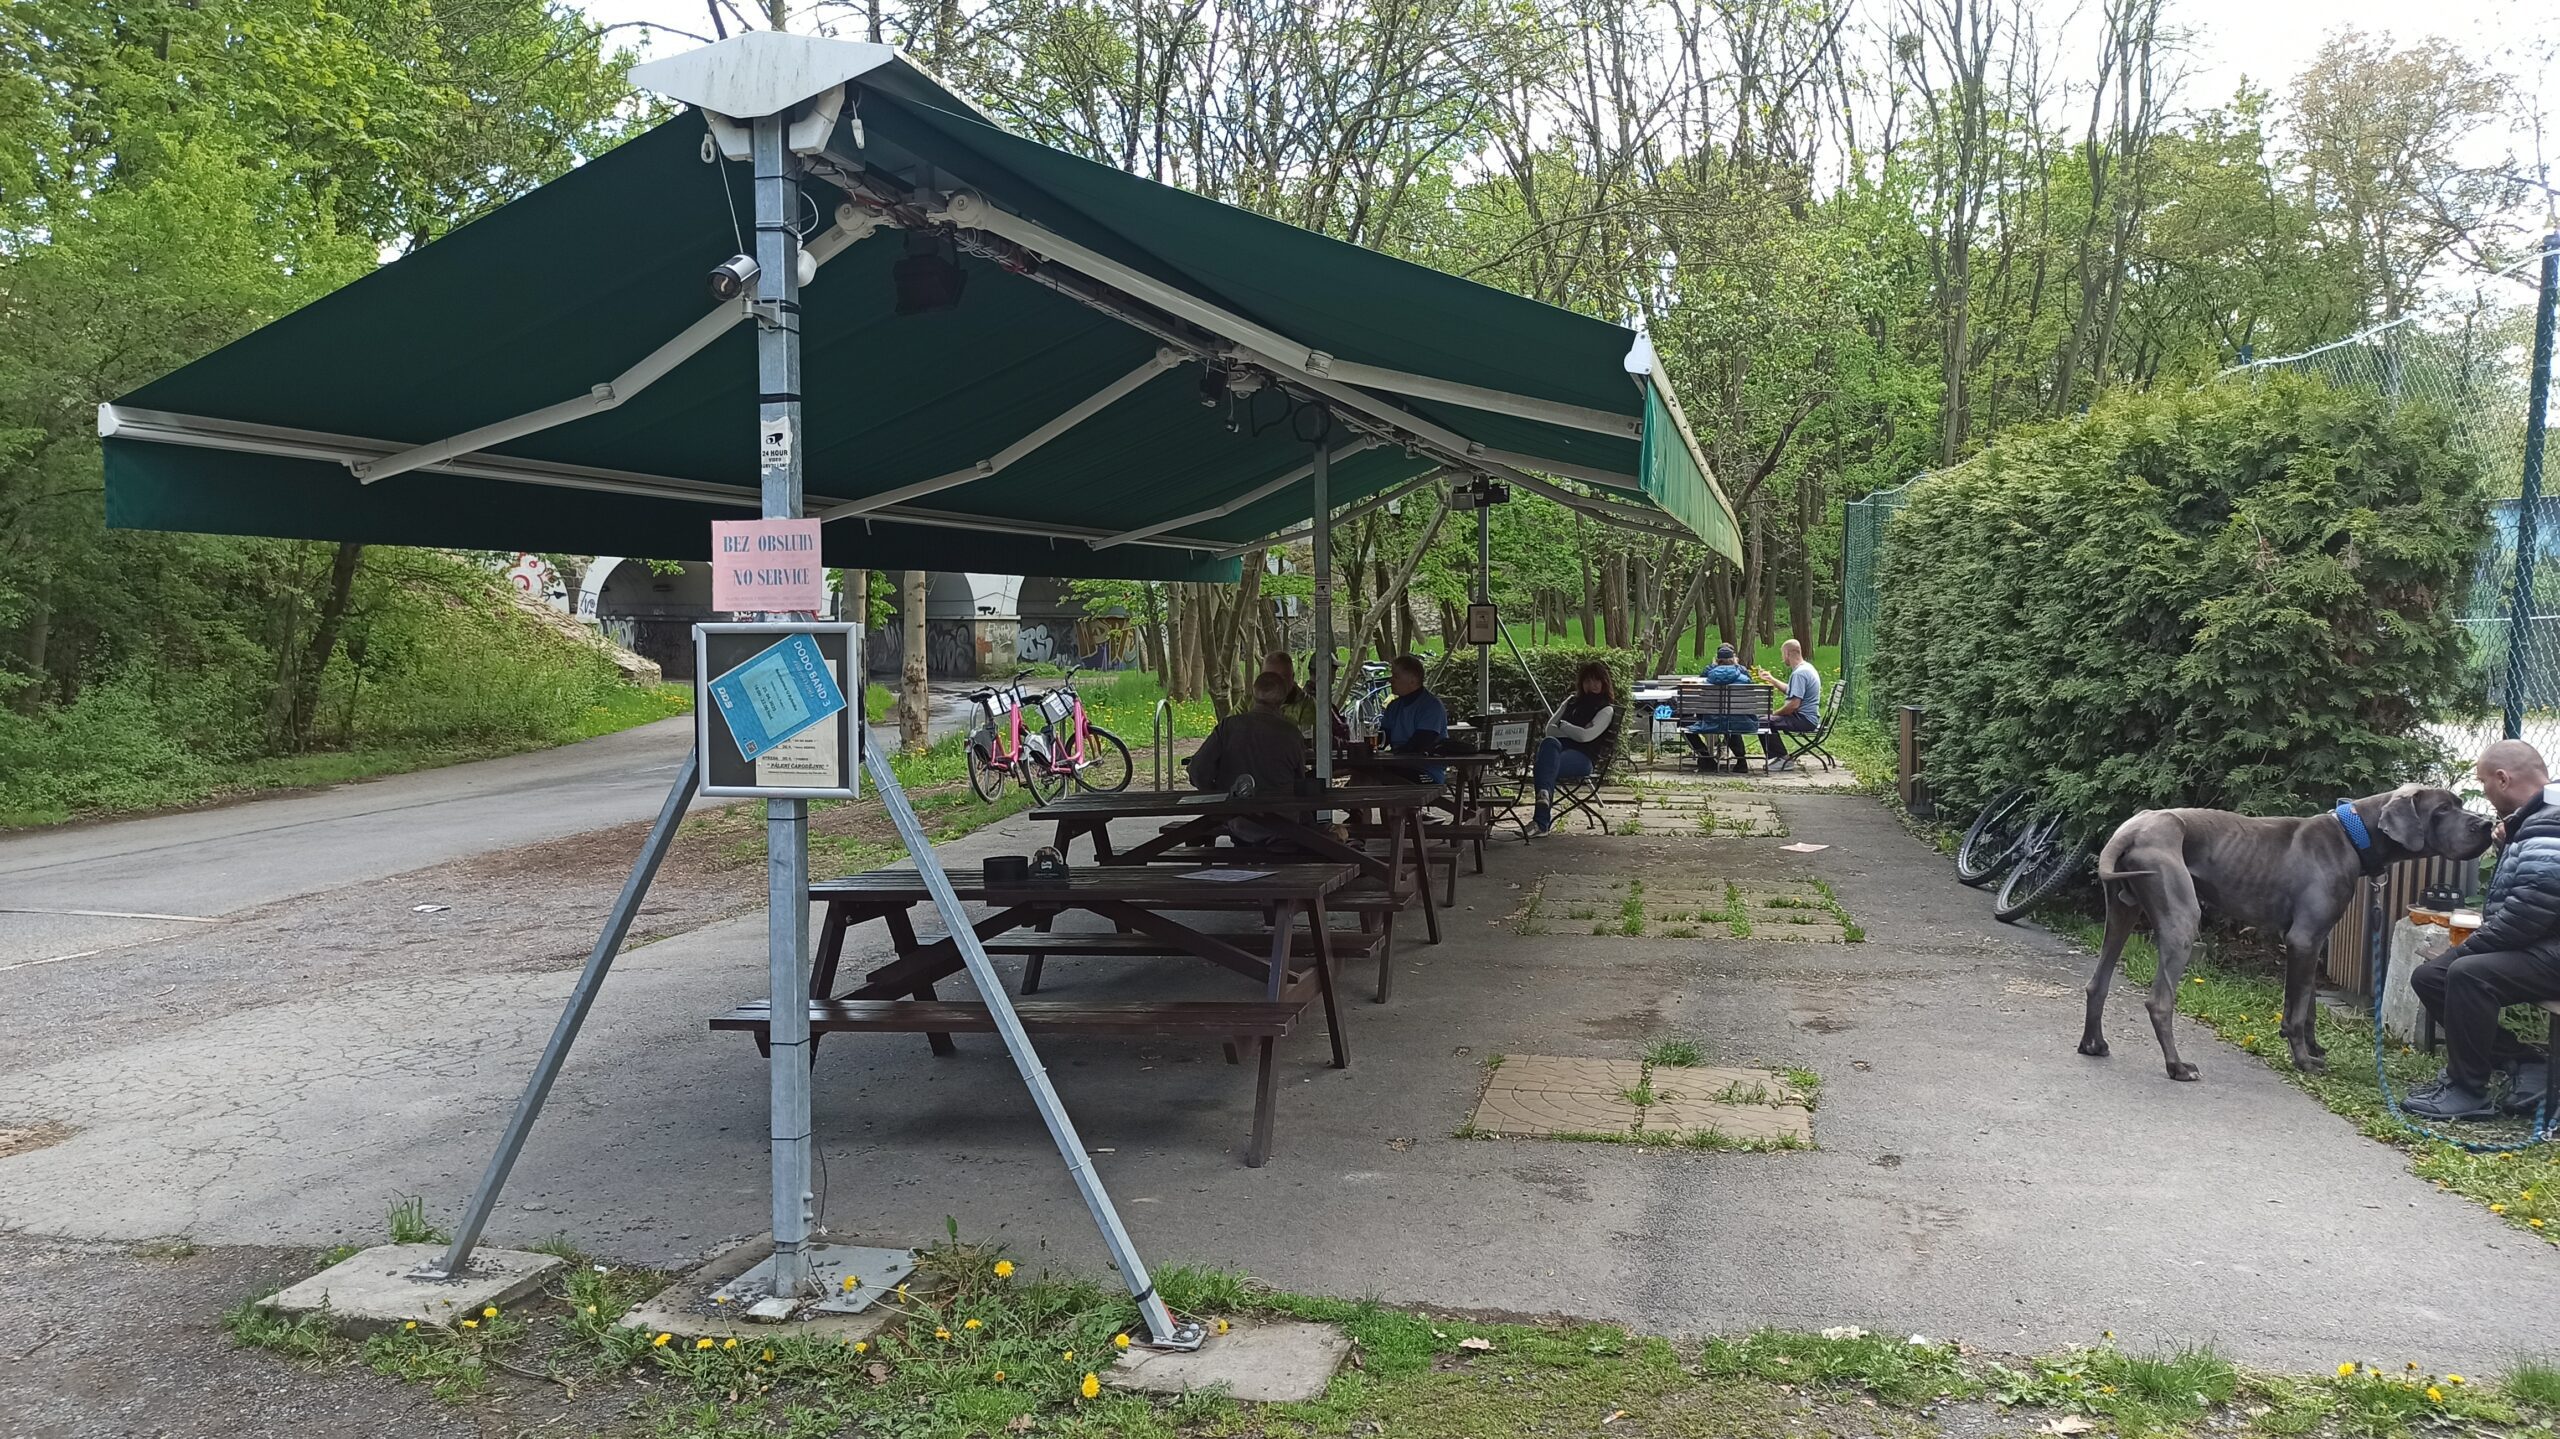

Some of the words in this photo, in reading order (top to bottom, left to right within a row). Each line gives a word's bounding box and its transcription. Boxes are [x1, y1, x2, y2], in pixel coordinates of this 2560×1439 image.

[770, 449, 788, 457] HOUR
[723, 535, 750, 553] BEZ
[758, 534, 814, 552] OBSLUHY
[733, 569, 753, 586] NO
[757, 568, 810, 586] SERVICE
[793, 641, 813, 671] DODO
[809, 671, 827, 699] BAND
